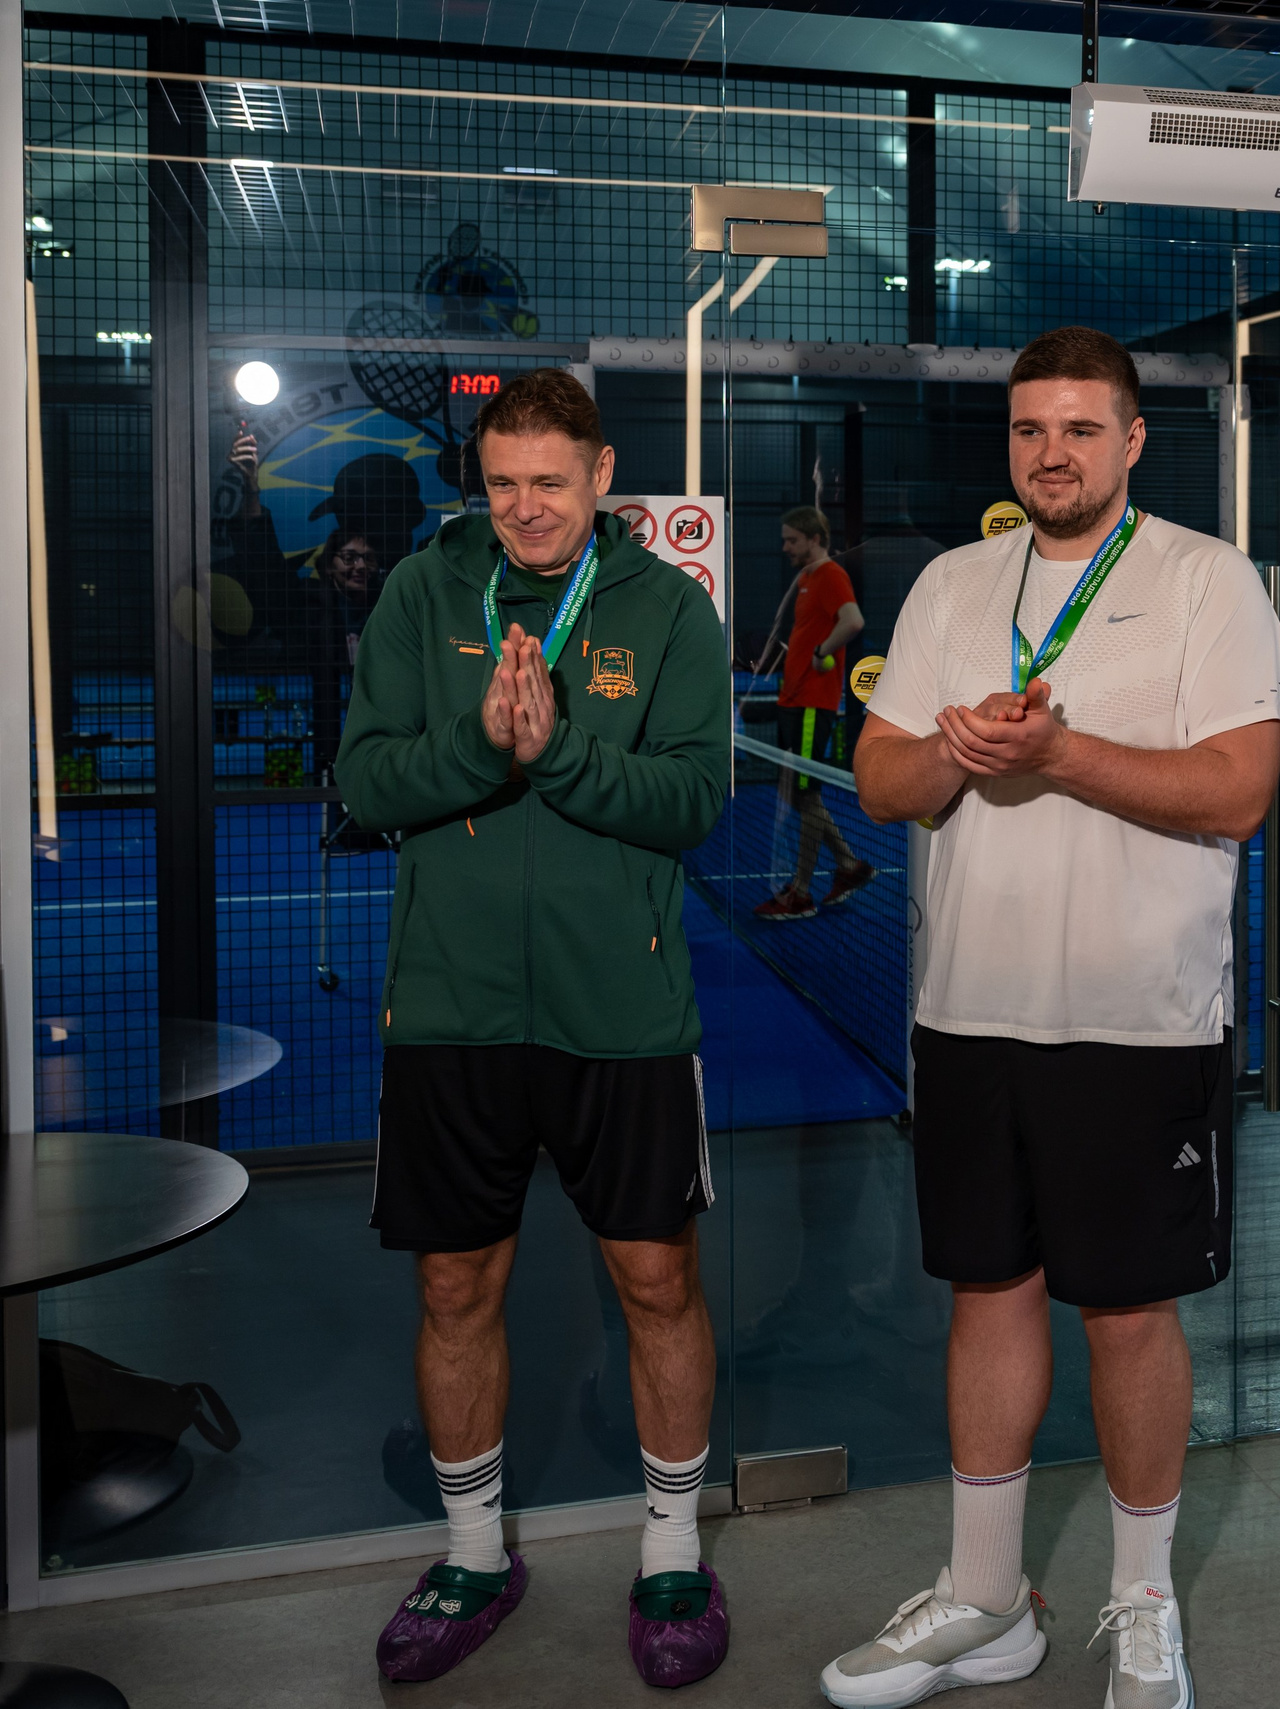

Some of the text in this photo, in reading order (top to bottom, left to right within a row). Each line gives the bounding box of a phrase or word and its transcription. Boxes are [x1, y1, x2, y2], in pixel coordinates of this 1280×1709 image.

[554, 548, 594, 629] КРАСНОДАРСКОГО КРАЯ
[565, 557, 598, 626] ФЕДЕРАЦИЯ ПАДЕЛА
[1069, 528, 1122, 606] КРАСНОДАРСКОГО КРАЯ
[1080, 539, 1125, 604] ФЕДЕРАЦИЯ ПАДЕЛА
